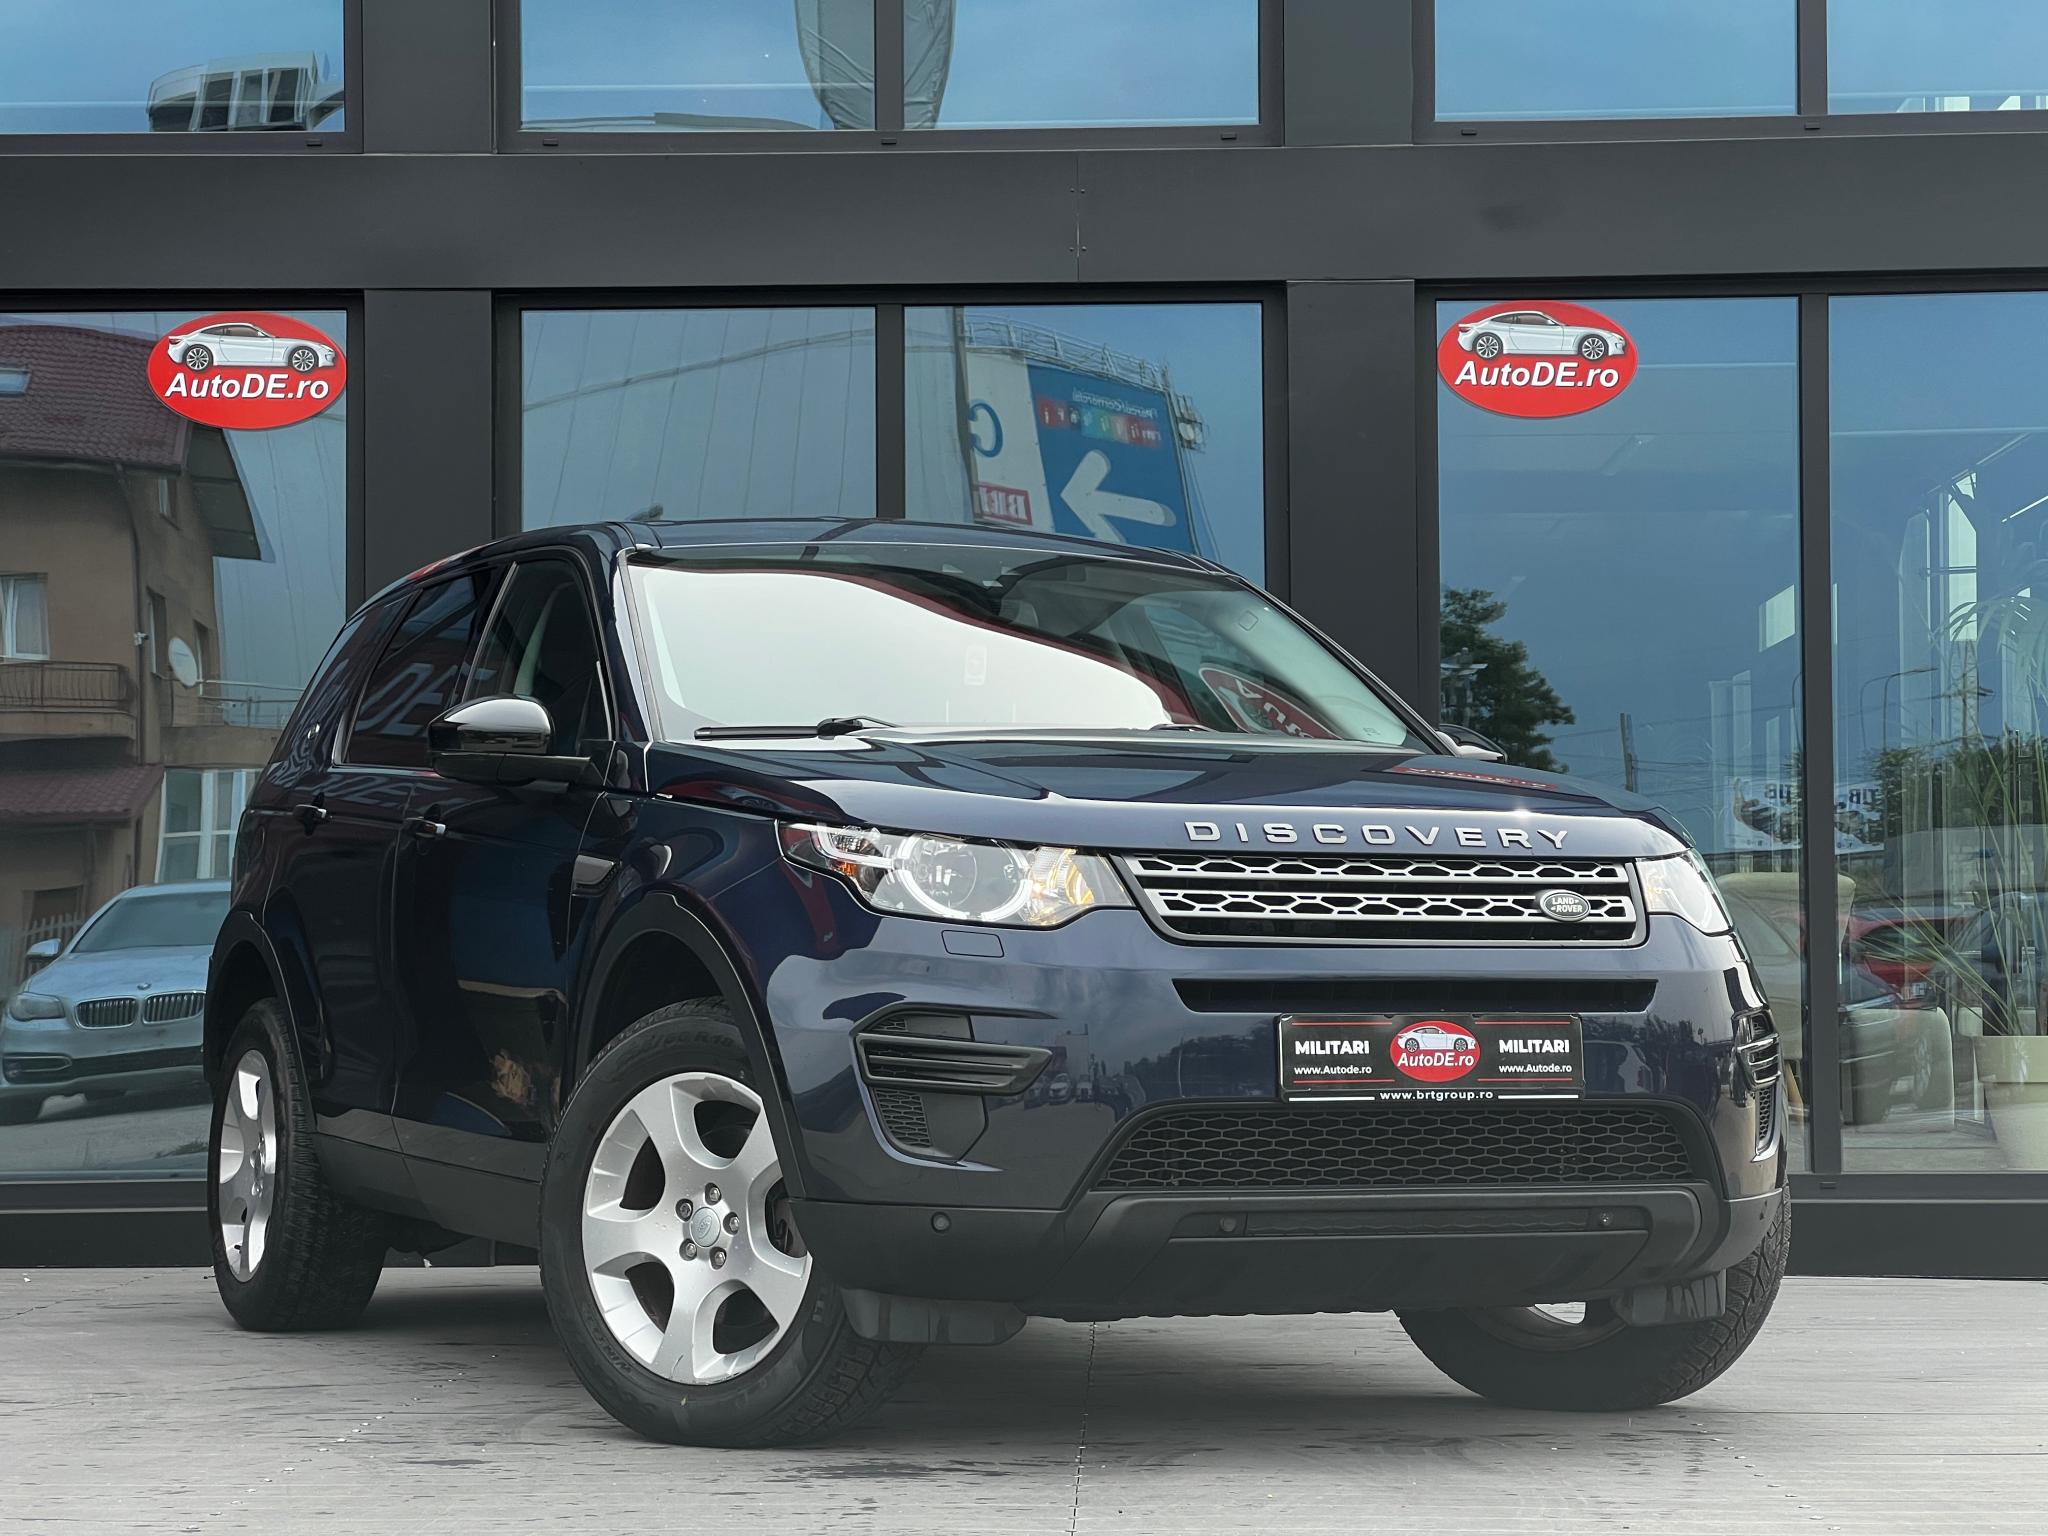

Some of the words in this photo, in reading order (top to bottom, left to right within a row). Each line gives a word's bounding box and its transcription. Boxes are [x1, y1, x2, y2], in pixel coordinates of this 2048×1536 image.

[1454, 360, 1619, 388] AutoDE.ro
[164, 372, 329, 399] AutoDE.ro
[1184, 820, 1570, 851] DISCOVERY
[1552, 897, 1574, 905] LAND
[1556, 904, 1583, 913] ROVER
[1294, 1040, 1370, 1055] MILITARI
[1499, 1039, 1570, 1054] MILITARI
[1397, 1052, 1475, 1068] AutoDE.ro
[1294, 1064, 1372, 1075] www.Autode.ro
[1498, 1063, 1573, 1074] www.Autode.ro
[1379, 1089, 1494, 1102] www.brtgroup.ro
